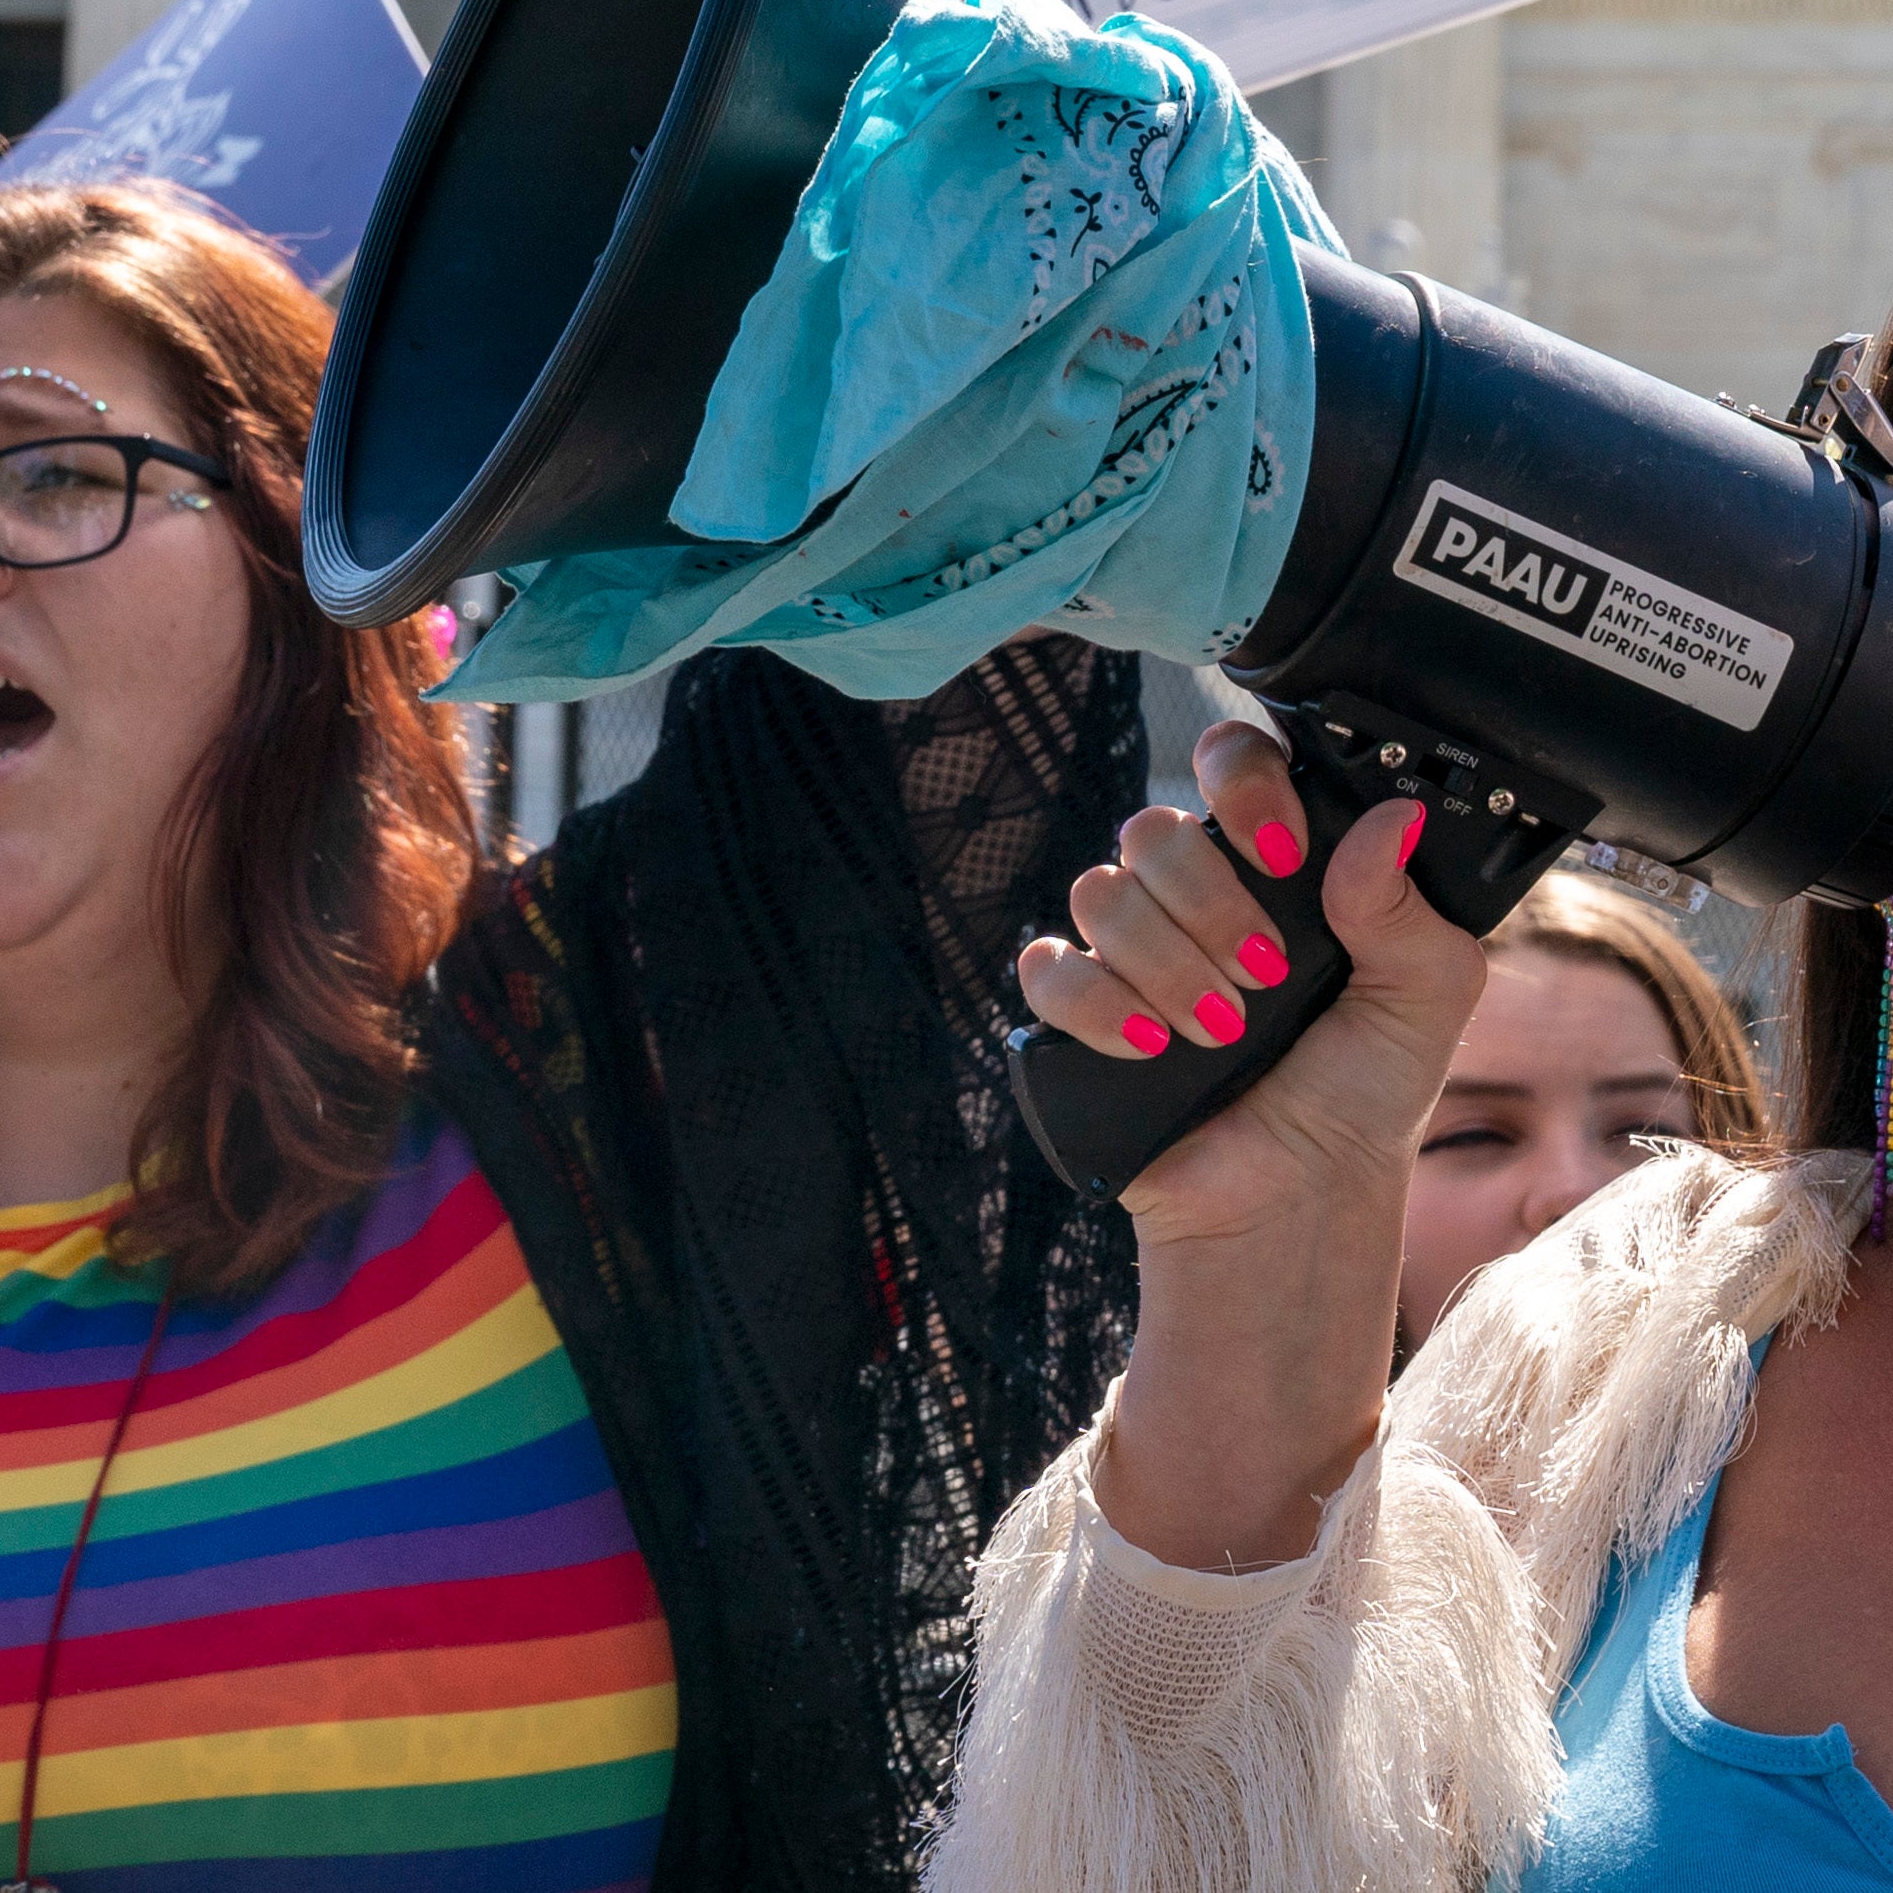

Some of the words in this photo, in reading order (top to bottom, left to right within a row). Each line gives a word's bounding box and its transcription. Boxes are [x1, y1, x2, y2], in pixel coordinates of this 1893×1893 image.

[1432, 516, 1587, 614] PAAU
[1610, 580, 1751, 656] PROGRESSIVE
[1589, 626, 1686, 680] UPRISING
[1598, 604, 1767, 689] ANTI-ABORTION
[1436, 741, 1479, 769] SIREN
[1396, 777, 1419, 794] ON
[1443, 797, 1472, 816] OFF
